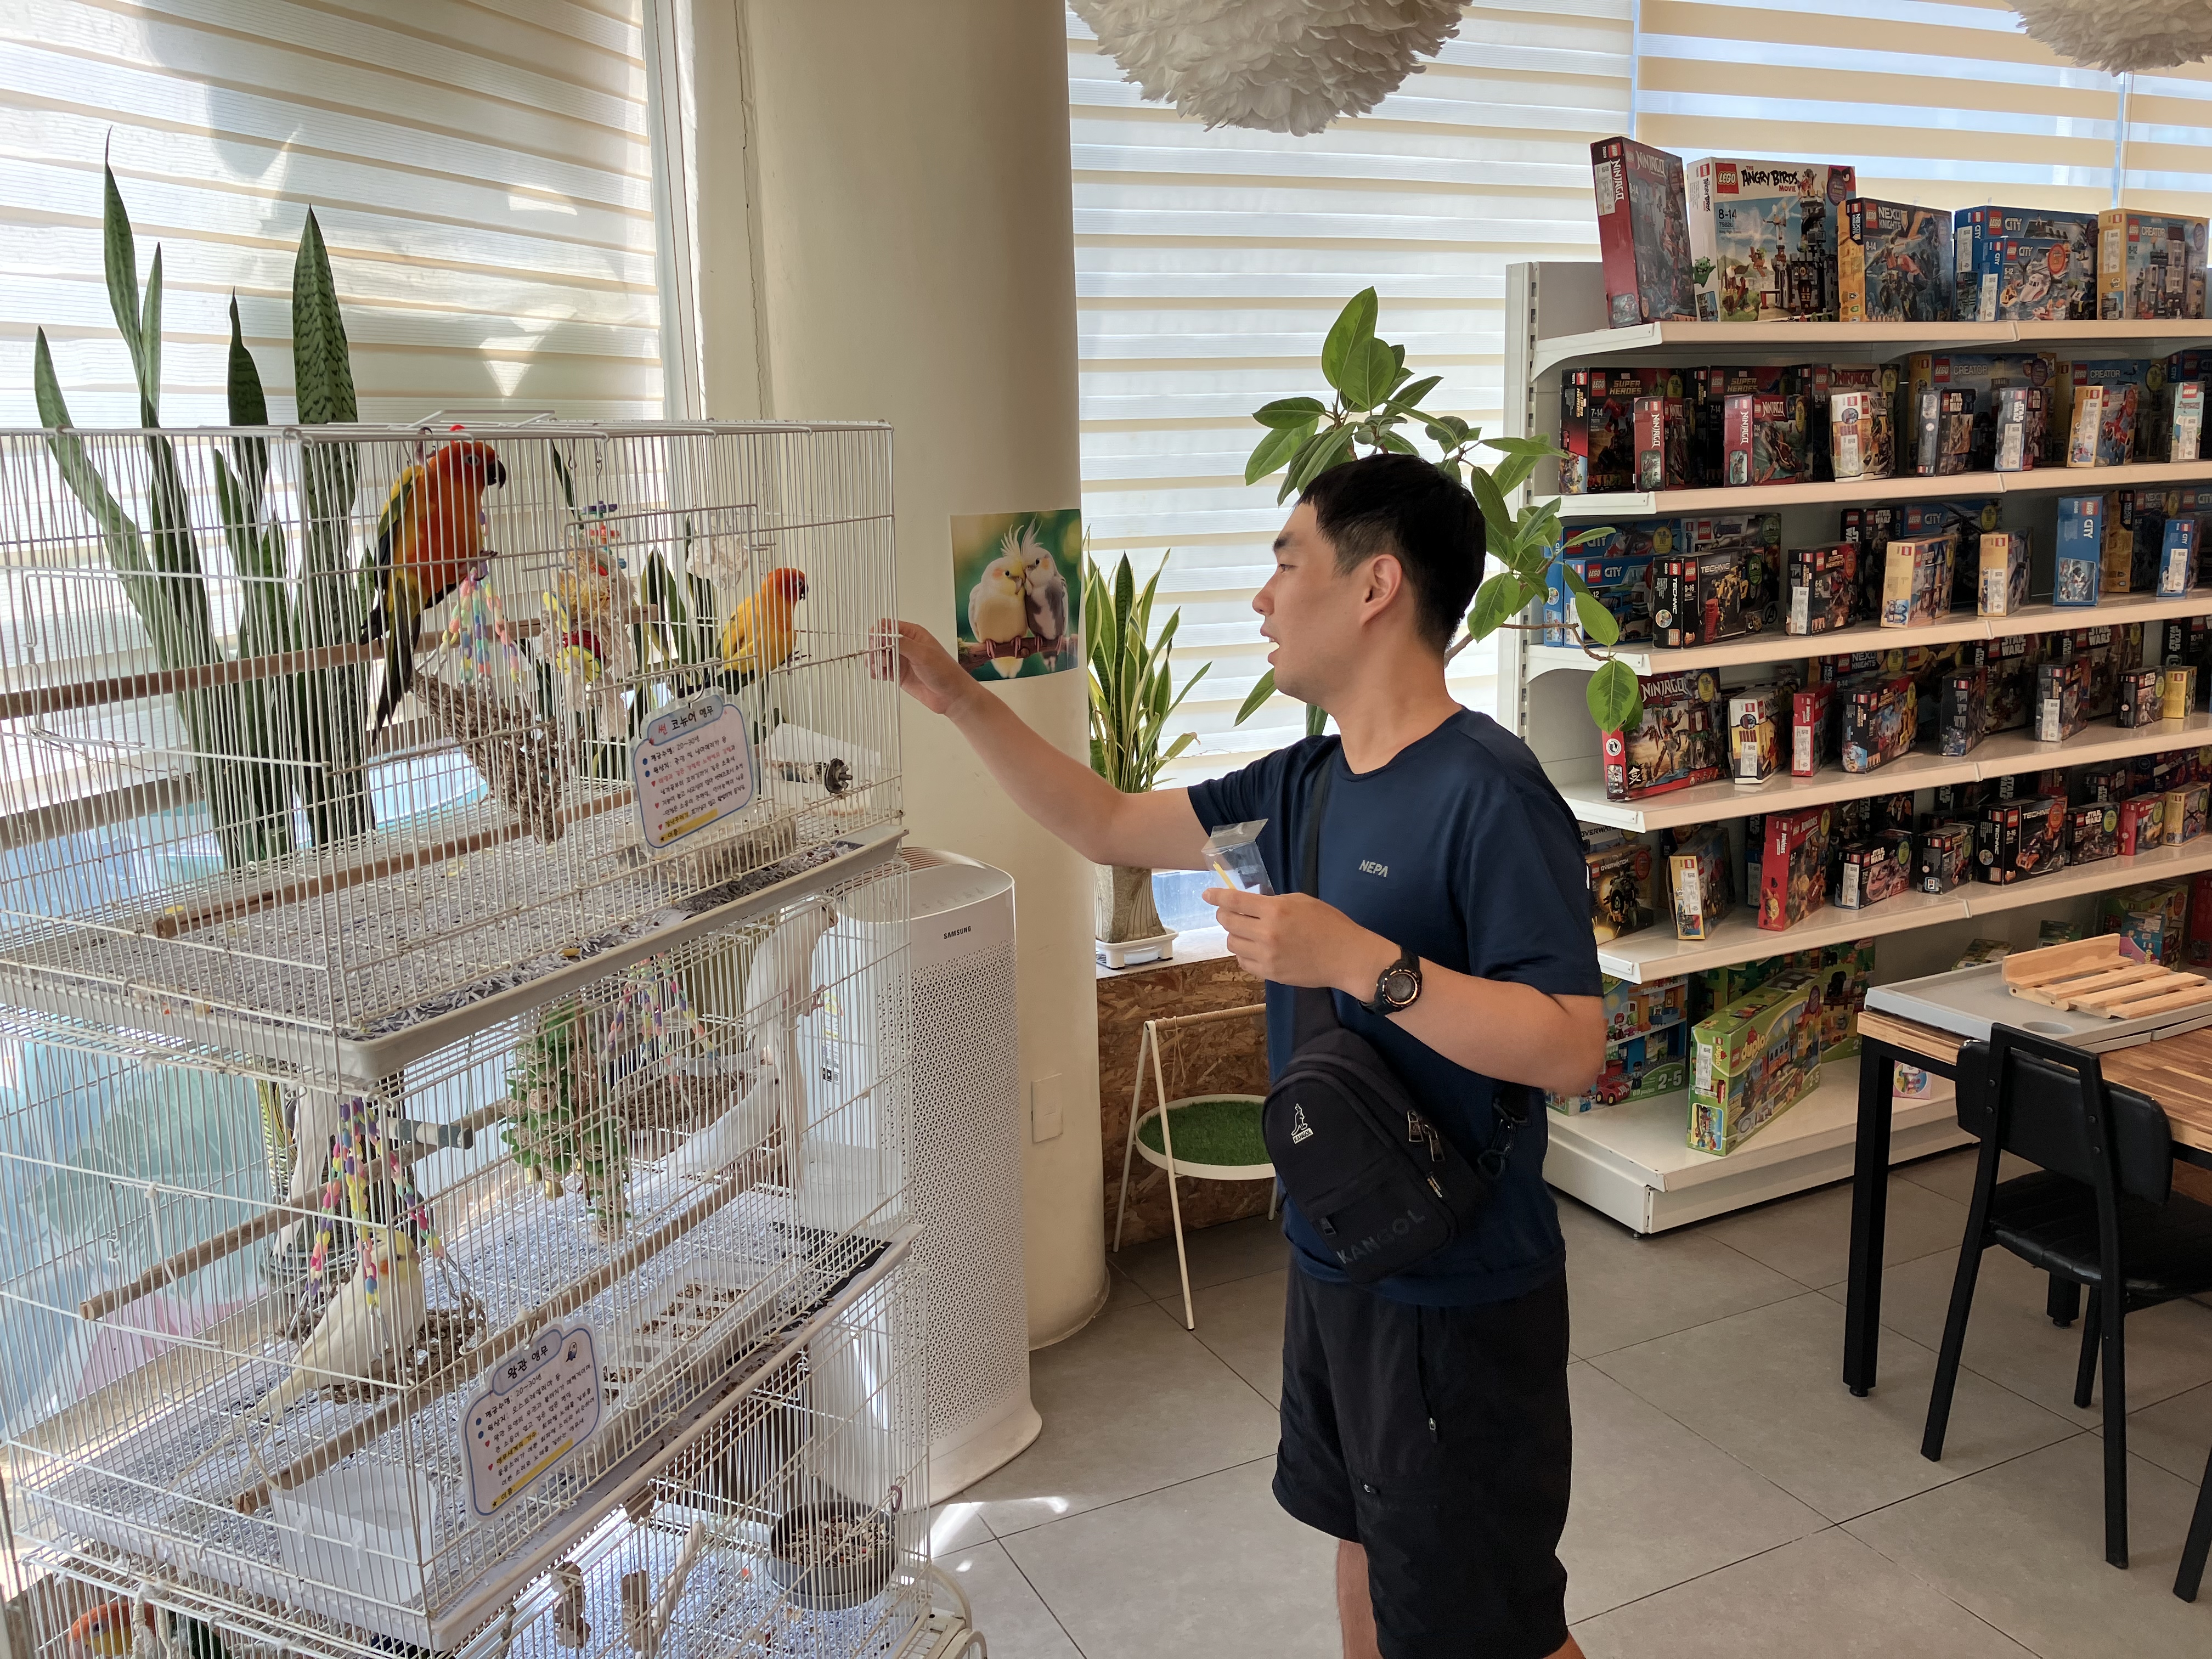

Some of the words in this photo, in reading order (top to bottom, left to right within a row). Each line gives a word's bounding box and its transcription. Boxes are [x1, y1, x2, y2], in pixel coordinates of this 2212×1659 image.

[1635, 150, 1667, 179] NINJAGO
[1610, 159, 1624, 204] NINJAGO
[1718, 171, 1737, 184] LEGO
[1741, 169, 1771, 187] ANGRY
[1770, 169, 1799, 187] BIRDS
[1779, 184, 1797, 193] MOVIE
[1718, 208, 1737, 220] 8-14
[1866, 210, 1876, 221] LEGO
[1878, 206, 1901, 221] NEXO
[1878, 219, 1902, 231] KNIGHTS
[1989, 217, 2002, 228] LEGO
[2005, 217, 2022, 232] CITY
[2129, 224, 2139, 236] LEGO
[2141, 225, 2166, 238] CREATOR
[1866, 241, 1876, 251] 8-14
[2006, 247, 2017, 256] LEGO
[2018, 246, 2033, 257] CITY
[1936, 364, 1949, 376] LEGO
[1953, 364, 1988, 375] CREATOR
[2074, 370, 2086, 379] LEGO
[2090, 369, 2121, 379] CREATOR
[1593, 379, 1605, 390] LEGO
[1712, 377, 1723, 387] LEGO
[1816, 374, 1827, 383] LEGO
[1609, 387, 1642, 395] HEROES
[1814, 394, 1826, 403] 8-14
[1591, 408, 1603, 417] 7-14
[1762, 401, 1786, 417] NINJAGO
[1651, 413, 1661, 449] NINJAGO
[1740, 410, 1749, 446] NINJAGO
[1908, 515, 1921, 524] LEGO
[1925, 512, 1942, 525] CITY
[2083, 518, 2094, 539] CITY
[1588, 567, 1601, 579] LEGO
[1604, 566, 1623, 578] CITY
[1685, 567, 1696, 576] LEGO
[1700, 562, 1730, 574] TECHNIC
[1684, 584, 1695, 592] 9-16
[2002, 635, 2026, 645] STAR
[2089, 632, 2112, 646] WARS
[1852, 651, 1876, 662] NEXO
[2002, 643, 2026, 657] WARS
[1852, 660, 1876, 670] KNIGHTS
[1641, 676, 1686, 703] NINJAGO
[658, 723, 668, 736] 썬
[671, 711, 697, 731] 코뉴어
[676, 735, 700, 751] 20~30년
[695, 739, 720, 755] 남아메리카
[680, 798, 693, 809] 소음이
[2085, 815, 2102, 825] WARS
[2087, 810, 2102, 819] STAR
[1872, 847, 1885, 856] STAR
[1358, 859, 1389, 877] NEPA
[1600, 858, 1629, 872] OVERWATCH
[944, 926, 972, 940] SAMSUNG
[1741, 1032, 1765, 1062] duplo
[1714, 1045, 1724, 1066] duplo
[1657, 1069, 1683, 1091] 2-5
[1293, 1128, 1312, 1143] KANGOL
[1336, 1209, 1426, 1265] KANGOL
[507, 1358, 528, 1379] 왕관
[531, 1345, 549, 1362] 앵무
[485, 1395, 514, 1418] 평균수명:
[515, 1373, 542, 1397] 20~30년
[487, 1412, 509, 1431] 원산지:
[512, 1379, 553, 1415] 오스트레일리아
[555, 1373, 561, 1381] 등
[560, 1401, 574, 1417] 노래를
[507, 1415, 523, 1432] 모양의
[504, 1431, 520, 1447] 소음이
[515, 1459, 532, 1476] 소리로
[534, 1444, 549, 1462] 노래를
